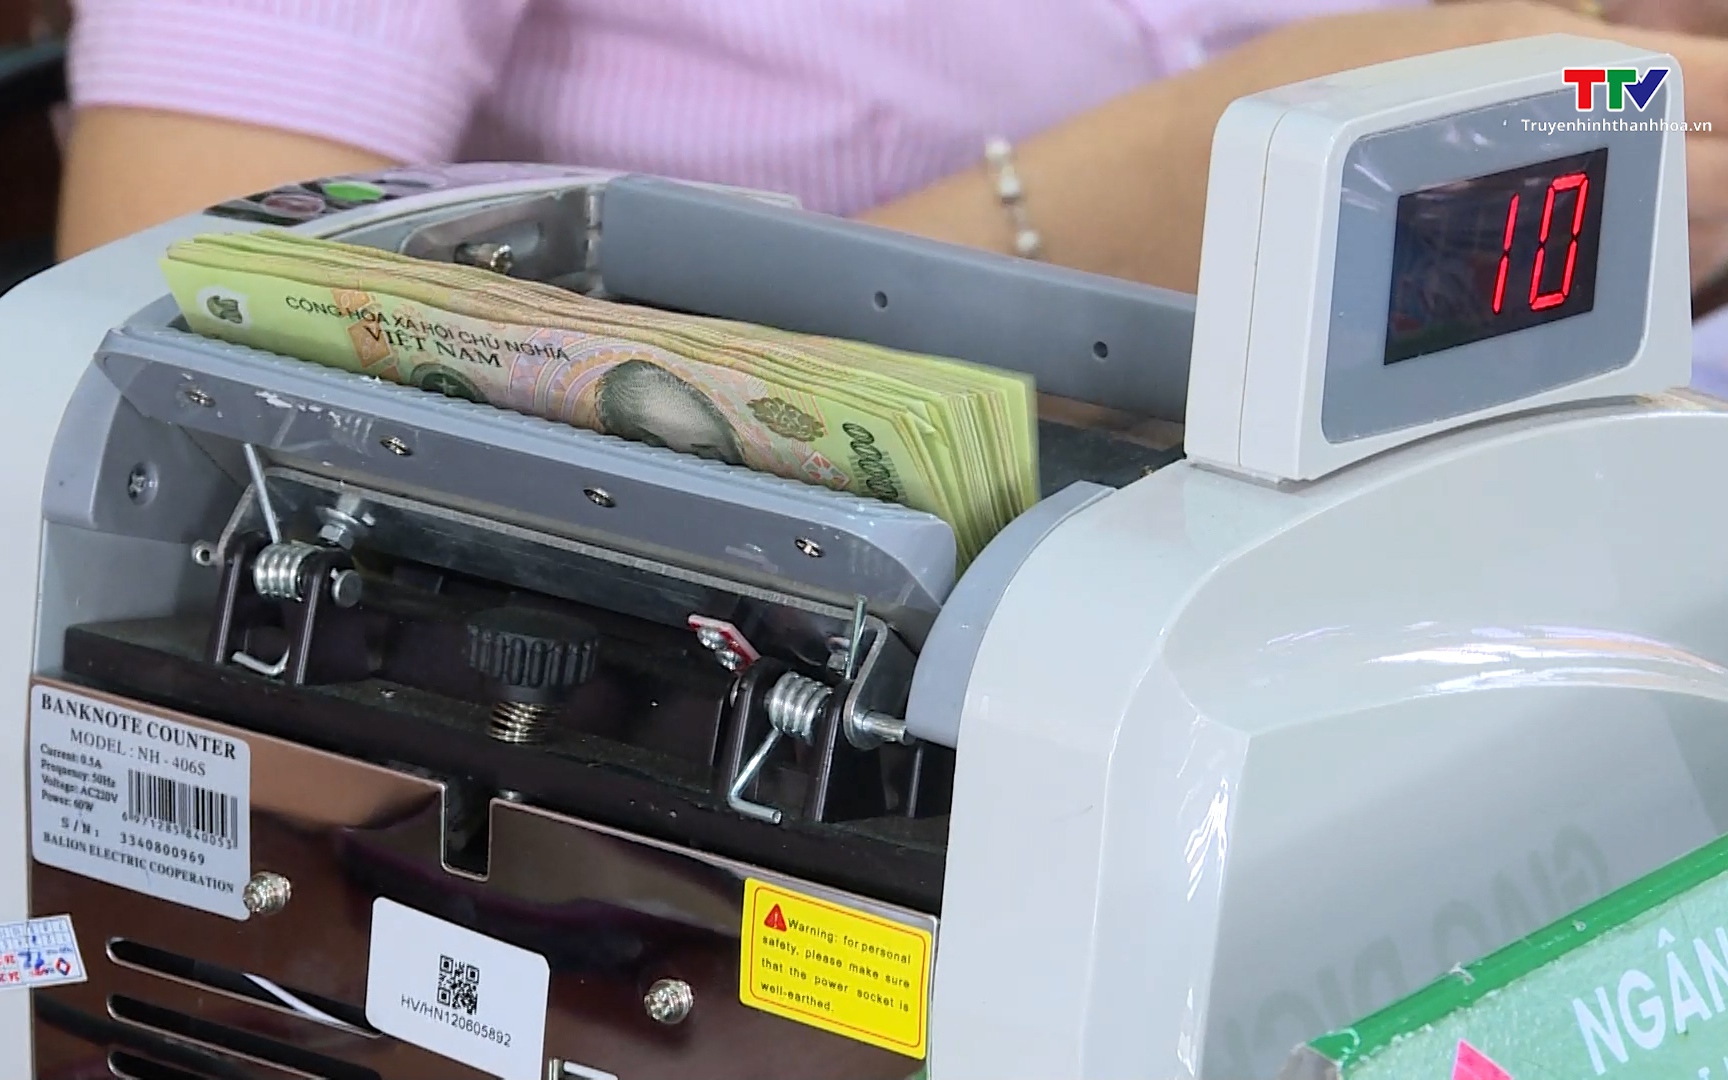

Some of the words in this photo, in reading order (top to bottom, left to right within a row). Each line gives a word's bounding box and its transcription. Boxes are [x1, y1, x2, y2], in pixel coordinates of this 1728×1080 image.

[1492, 171, 1590, 315] 10
[435, 340, 502, 368] NAM
[41, 692, 143, 735] BANKNOTE
[147, 720, 236, 760] COUNTER
[171, 756, 206, 777] 406S
[80, 785, 119, 804] AC220V
[43, 831, 87, 852] BALION
[89, 845, 147, 870] ELECTRIC
[149, 860, 235, 894] COOPERATION
[120, 831, 205, 866] 3340800969
[762, 935, 800, 956] safety,
[805, 949, 843, 968] please
[849, 962, 879, 980] make
[885, 973, 910, 989] sure
[788, 918, 838, 943] Warning:
[843, 935, 860, 949] for
[861, 942, 911, 966] personal
[760, 980, 835, 1012] well-earthed.
[761, 957, 783, 972] that
[789, 966, 807, 980] the
[814, 974, 849, 994] power
[856, 988, 894, 1008] socket
[899, 999, 910, 1013] is
[400, 993, 512, 1048] HV/HN120605892
